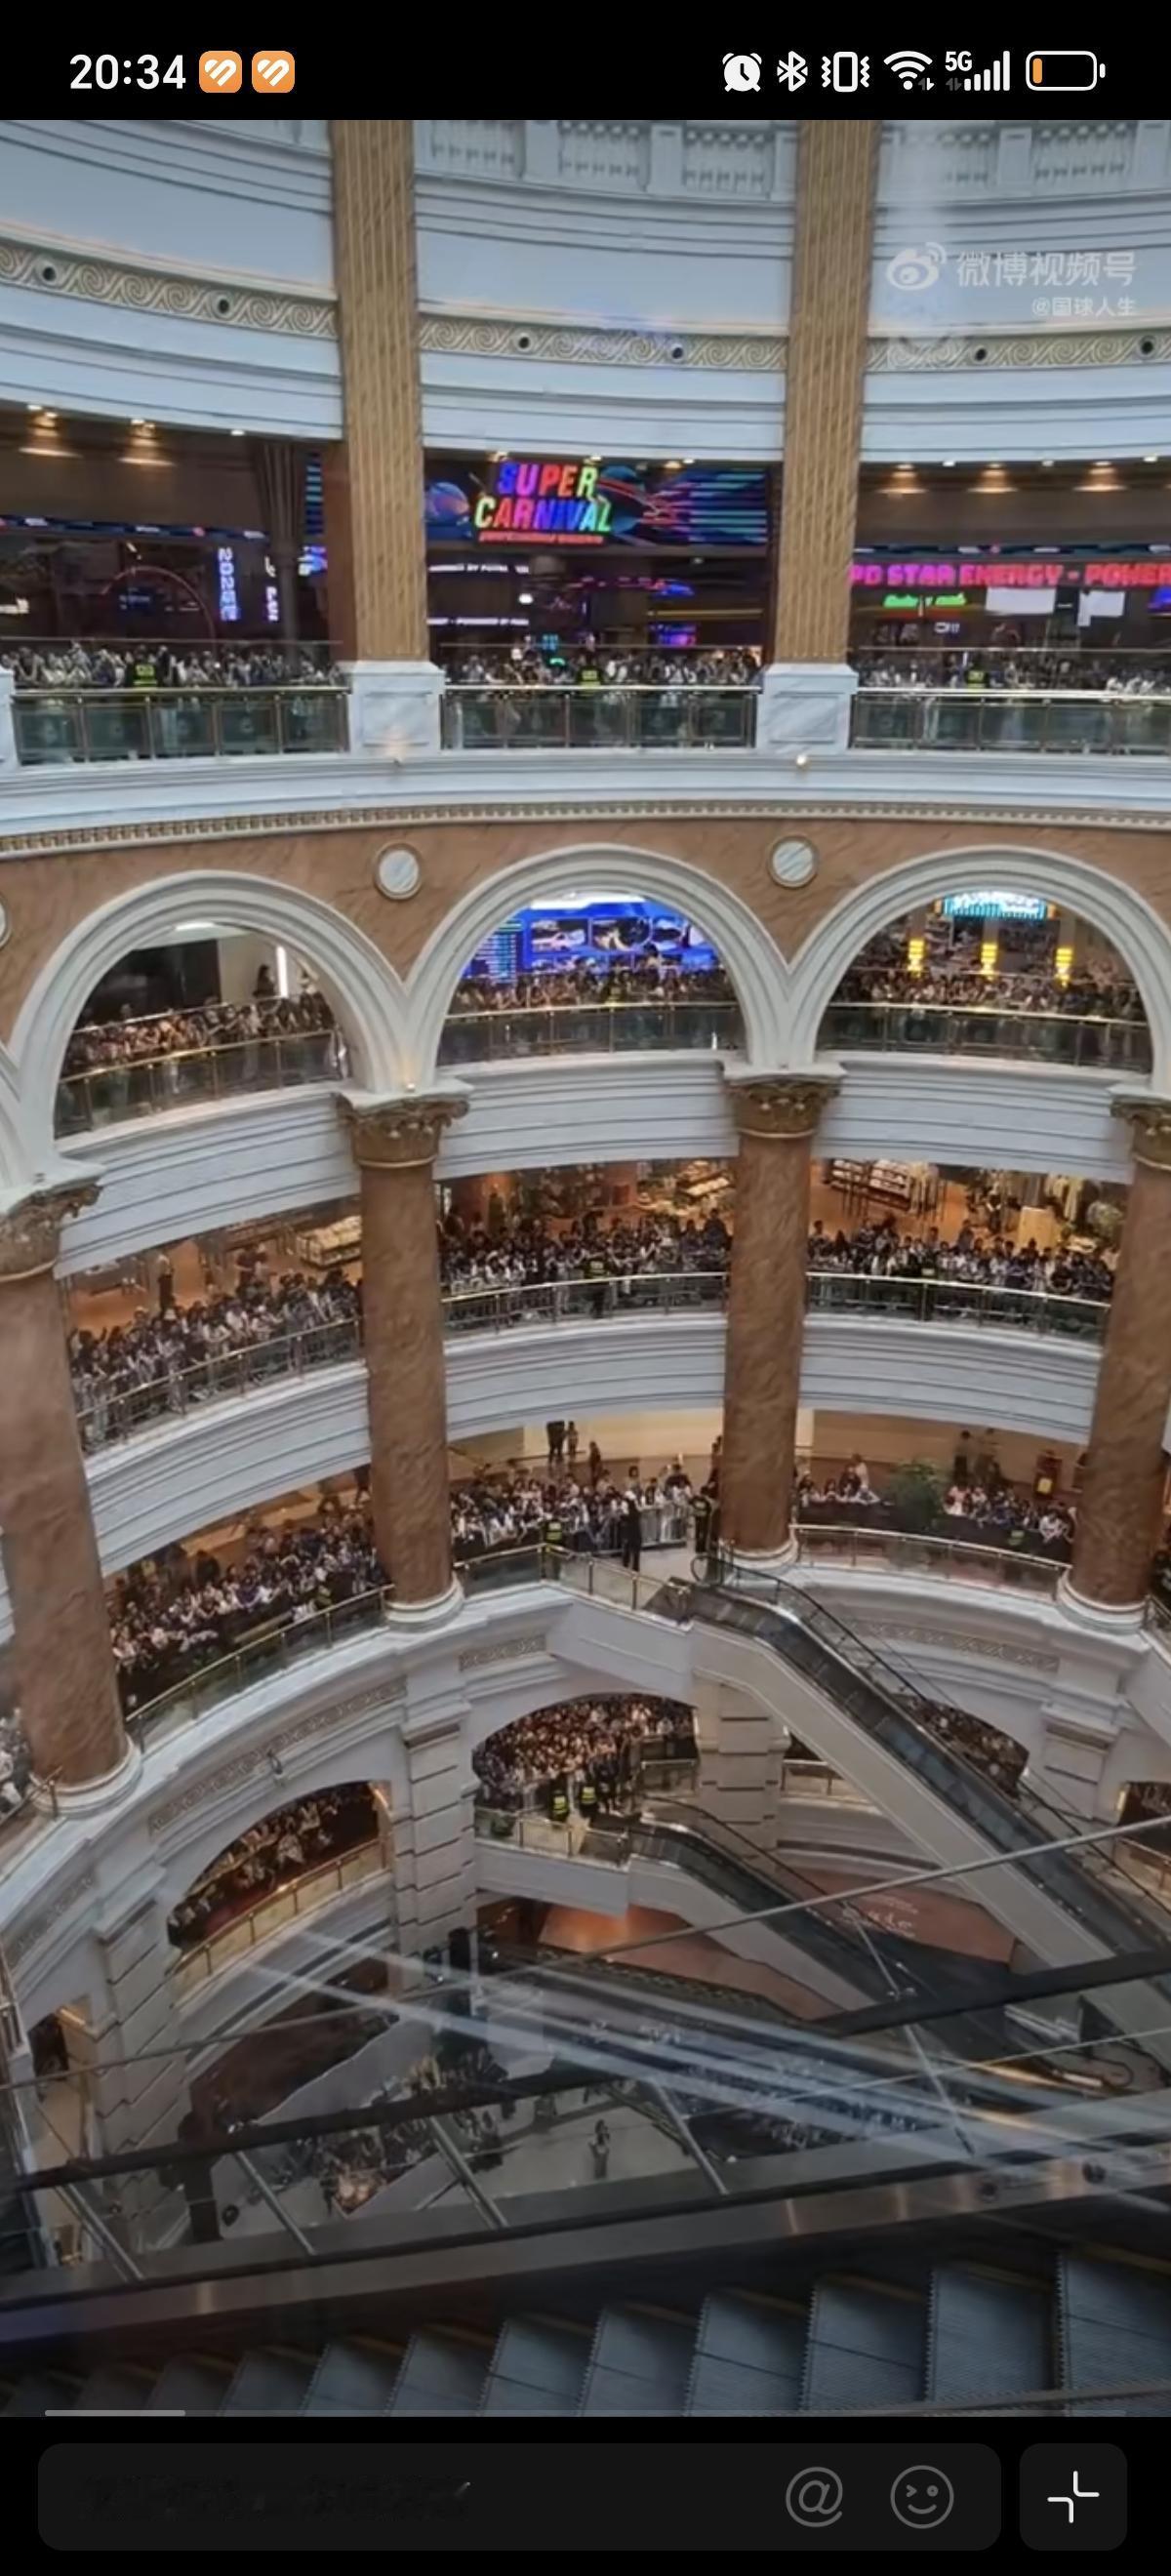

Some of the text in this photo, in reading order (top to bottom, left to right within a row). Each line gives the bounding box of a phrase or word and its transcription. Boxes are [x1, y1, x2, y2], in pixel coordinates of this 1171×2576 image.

[498, 462, 600, 498] SUPER
[474, 495, 613, 534] CARNIVAL
[887, 563, 955, 585] STAR
[959, 563, 1063, 586] ENERGY
[1084, 563, 1171, 586] POWER
